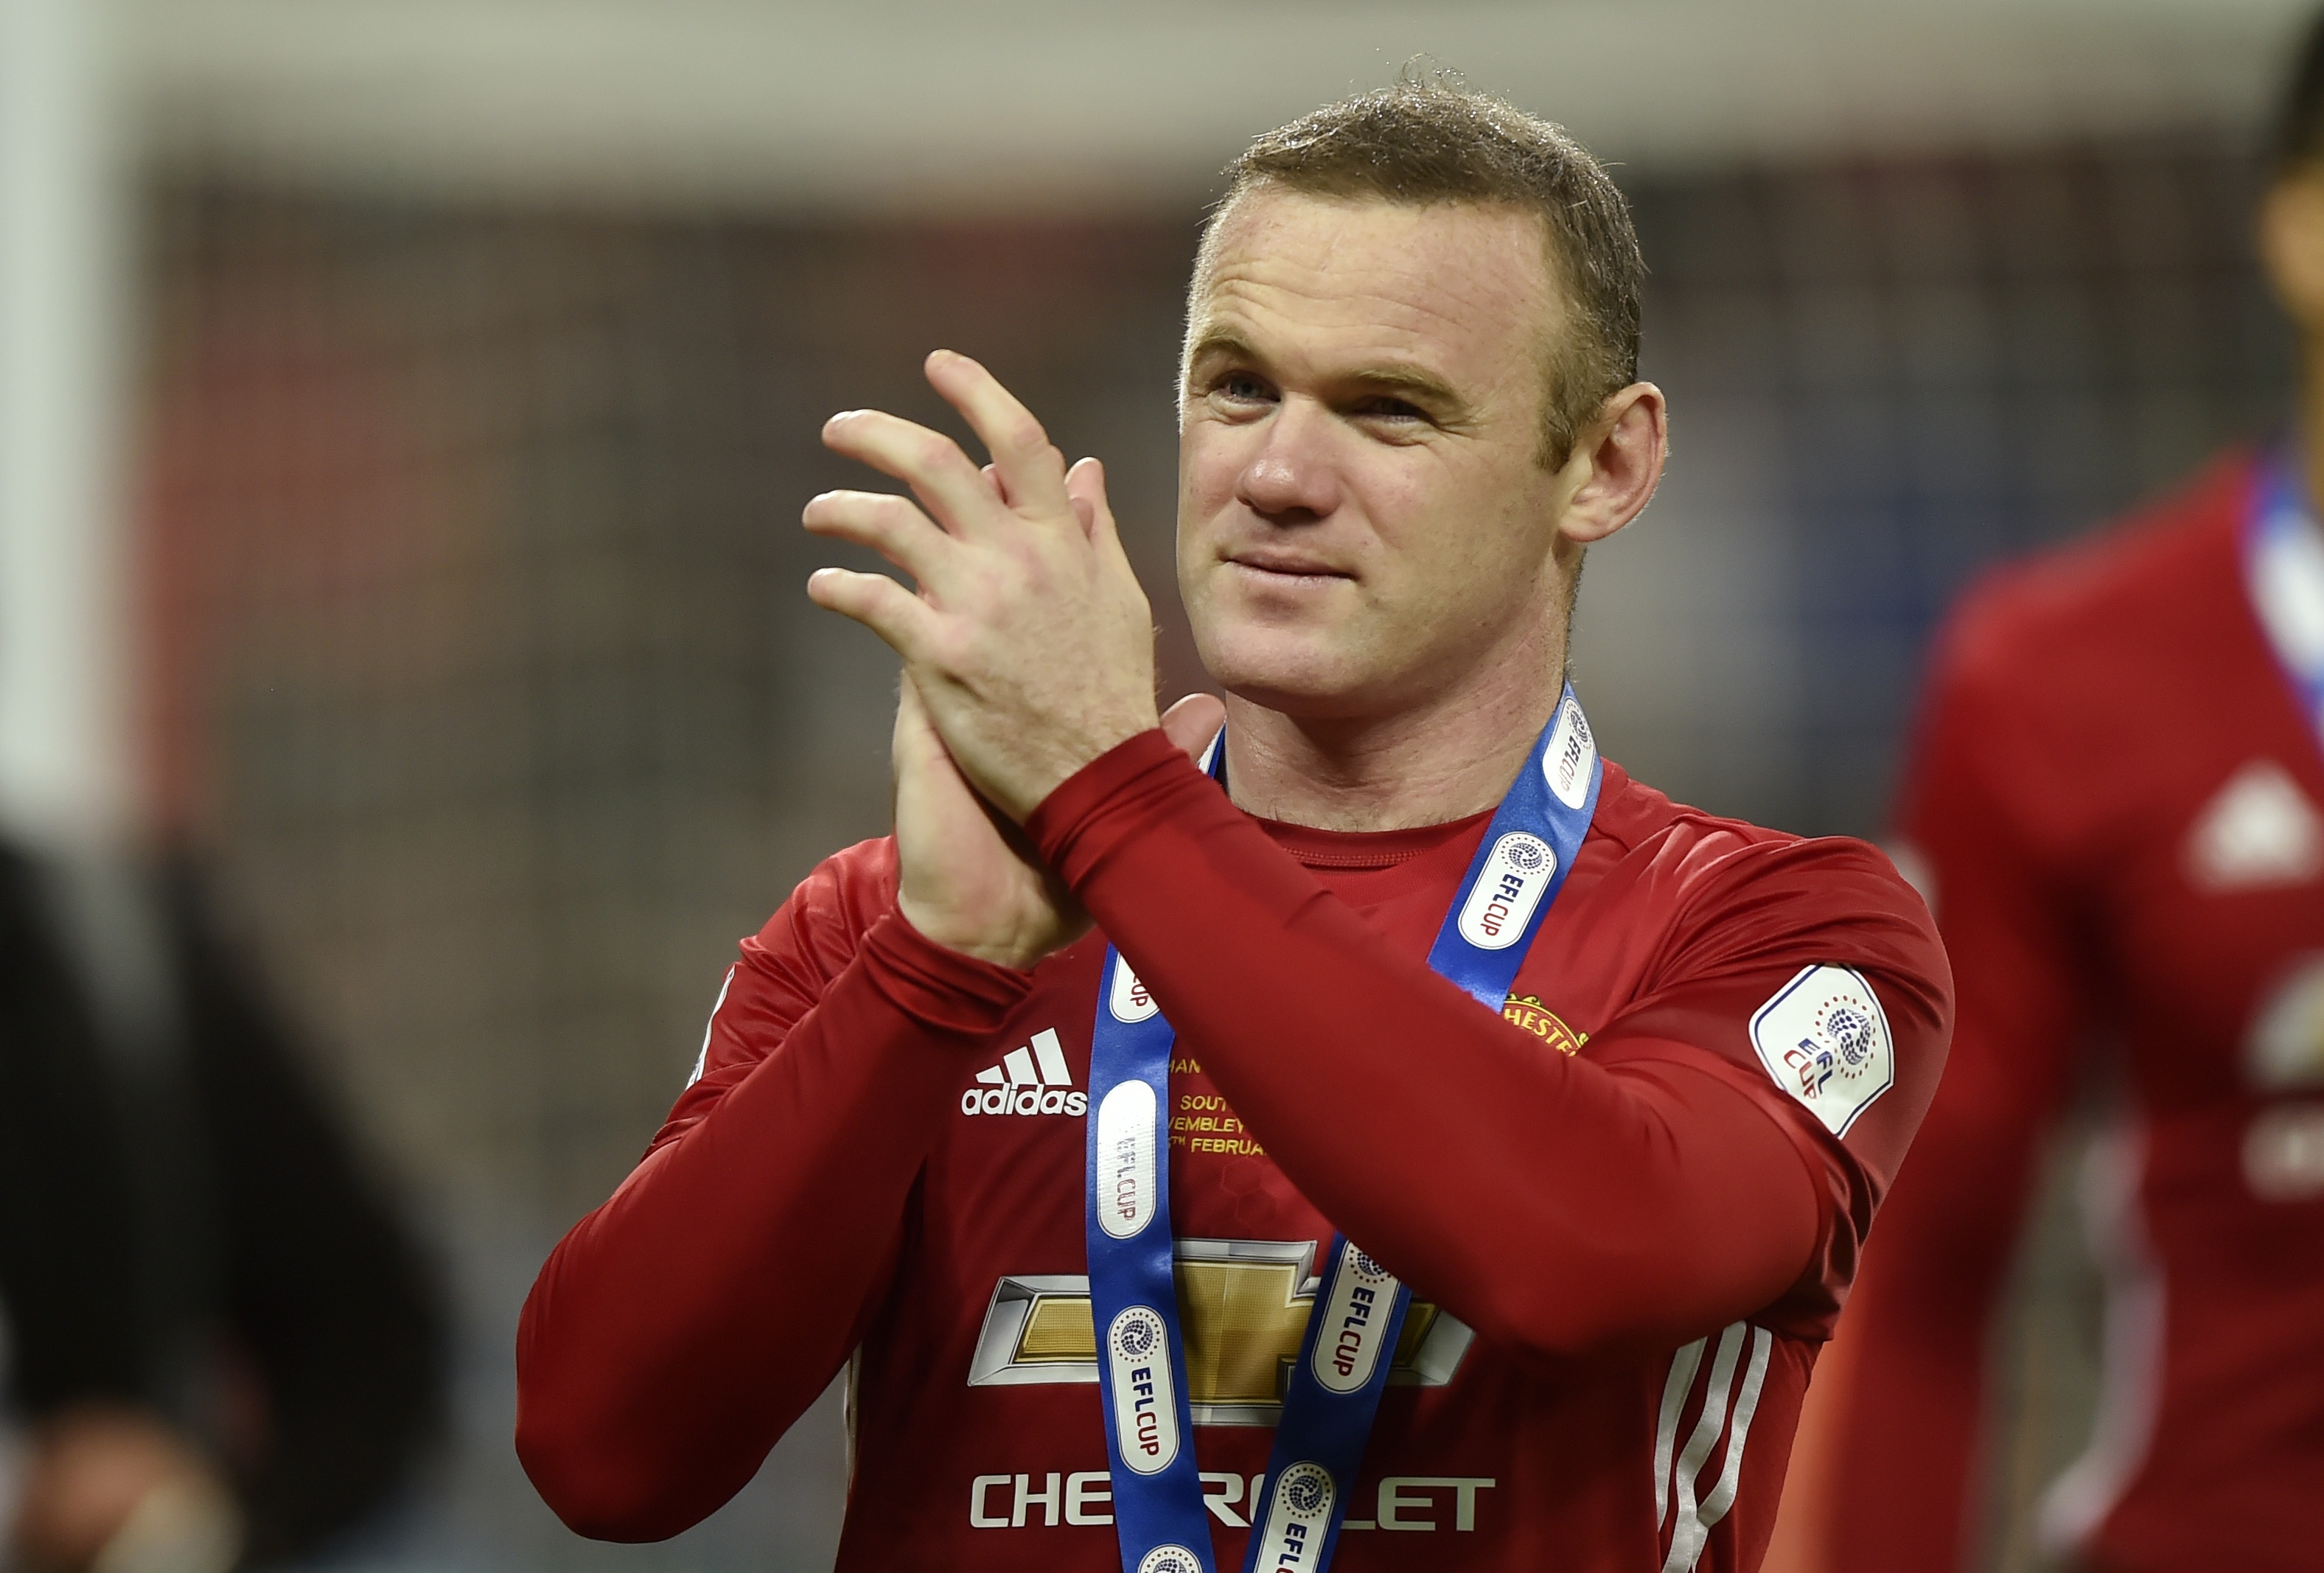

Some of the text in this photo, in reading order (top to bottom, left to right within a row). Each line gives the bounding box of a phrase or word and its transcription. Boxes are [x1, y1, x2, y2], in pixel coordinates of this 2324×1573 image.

[1130, 975, 1149, 1007] UP
[1504, 1008, 1577, 1057] HESTE
[961, 1082, 1089, 1117] adidas
[1180, 1095, 1227, 1112] SOUT
[1168, 1135, 1267, 1156] TH FEBRUA
[970, 1471, 1496, 1532] CHERET
